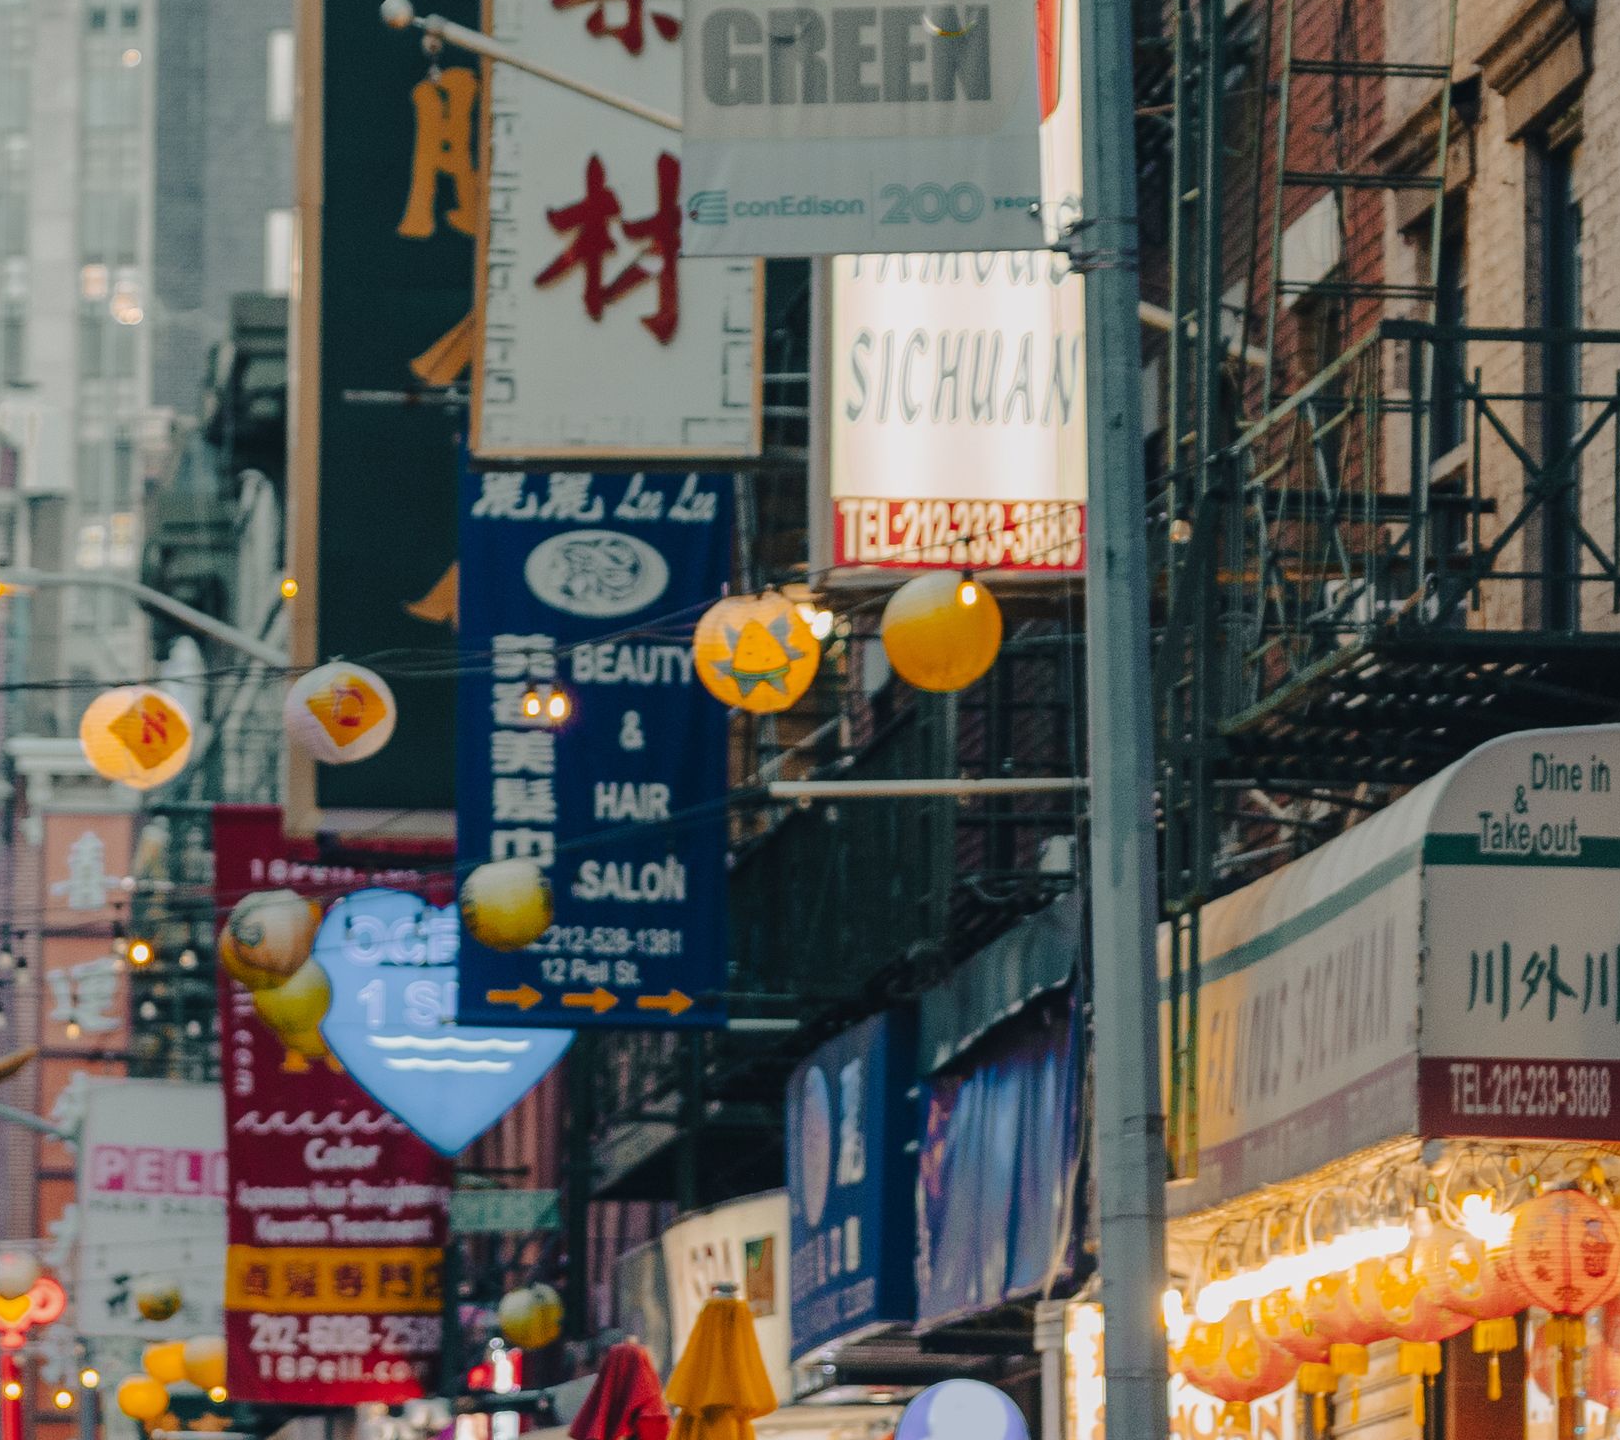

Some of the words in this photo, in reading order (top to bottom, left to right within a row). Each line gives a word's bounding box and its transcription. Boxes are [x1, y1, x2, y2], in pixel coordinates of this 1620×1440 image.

[702, 3, 992, 107] GREEN
[733, 190, 864, 218] conEdison
[879, 181, 985, 224] 200
[843, 325, 1081, 426] SICHUAN
[573, 643, 696, 685] BEAUTY
[619, 709, 645, 751] &
[1530, 752, 1582, 791] Dine
[1590, 754, 1611, 792] in
[593, 781, 672, 822] HAIR
[1514, 783, 1528, 814] &
[1479, 811, 1531, 850] Take
[1538, 816, 1578, 852] out
[572, 856, 687, 903] SALON
[541, 959, 565, 985] 12
[569, 960, 611, 986] Pell
